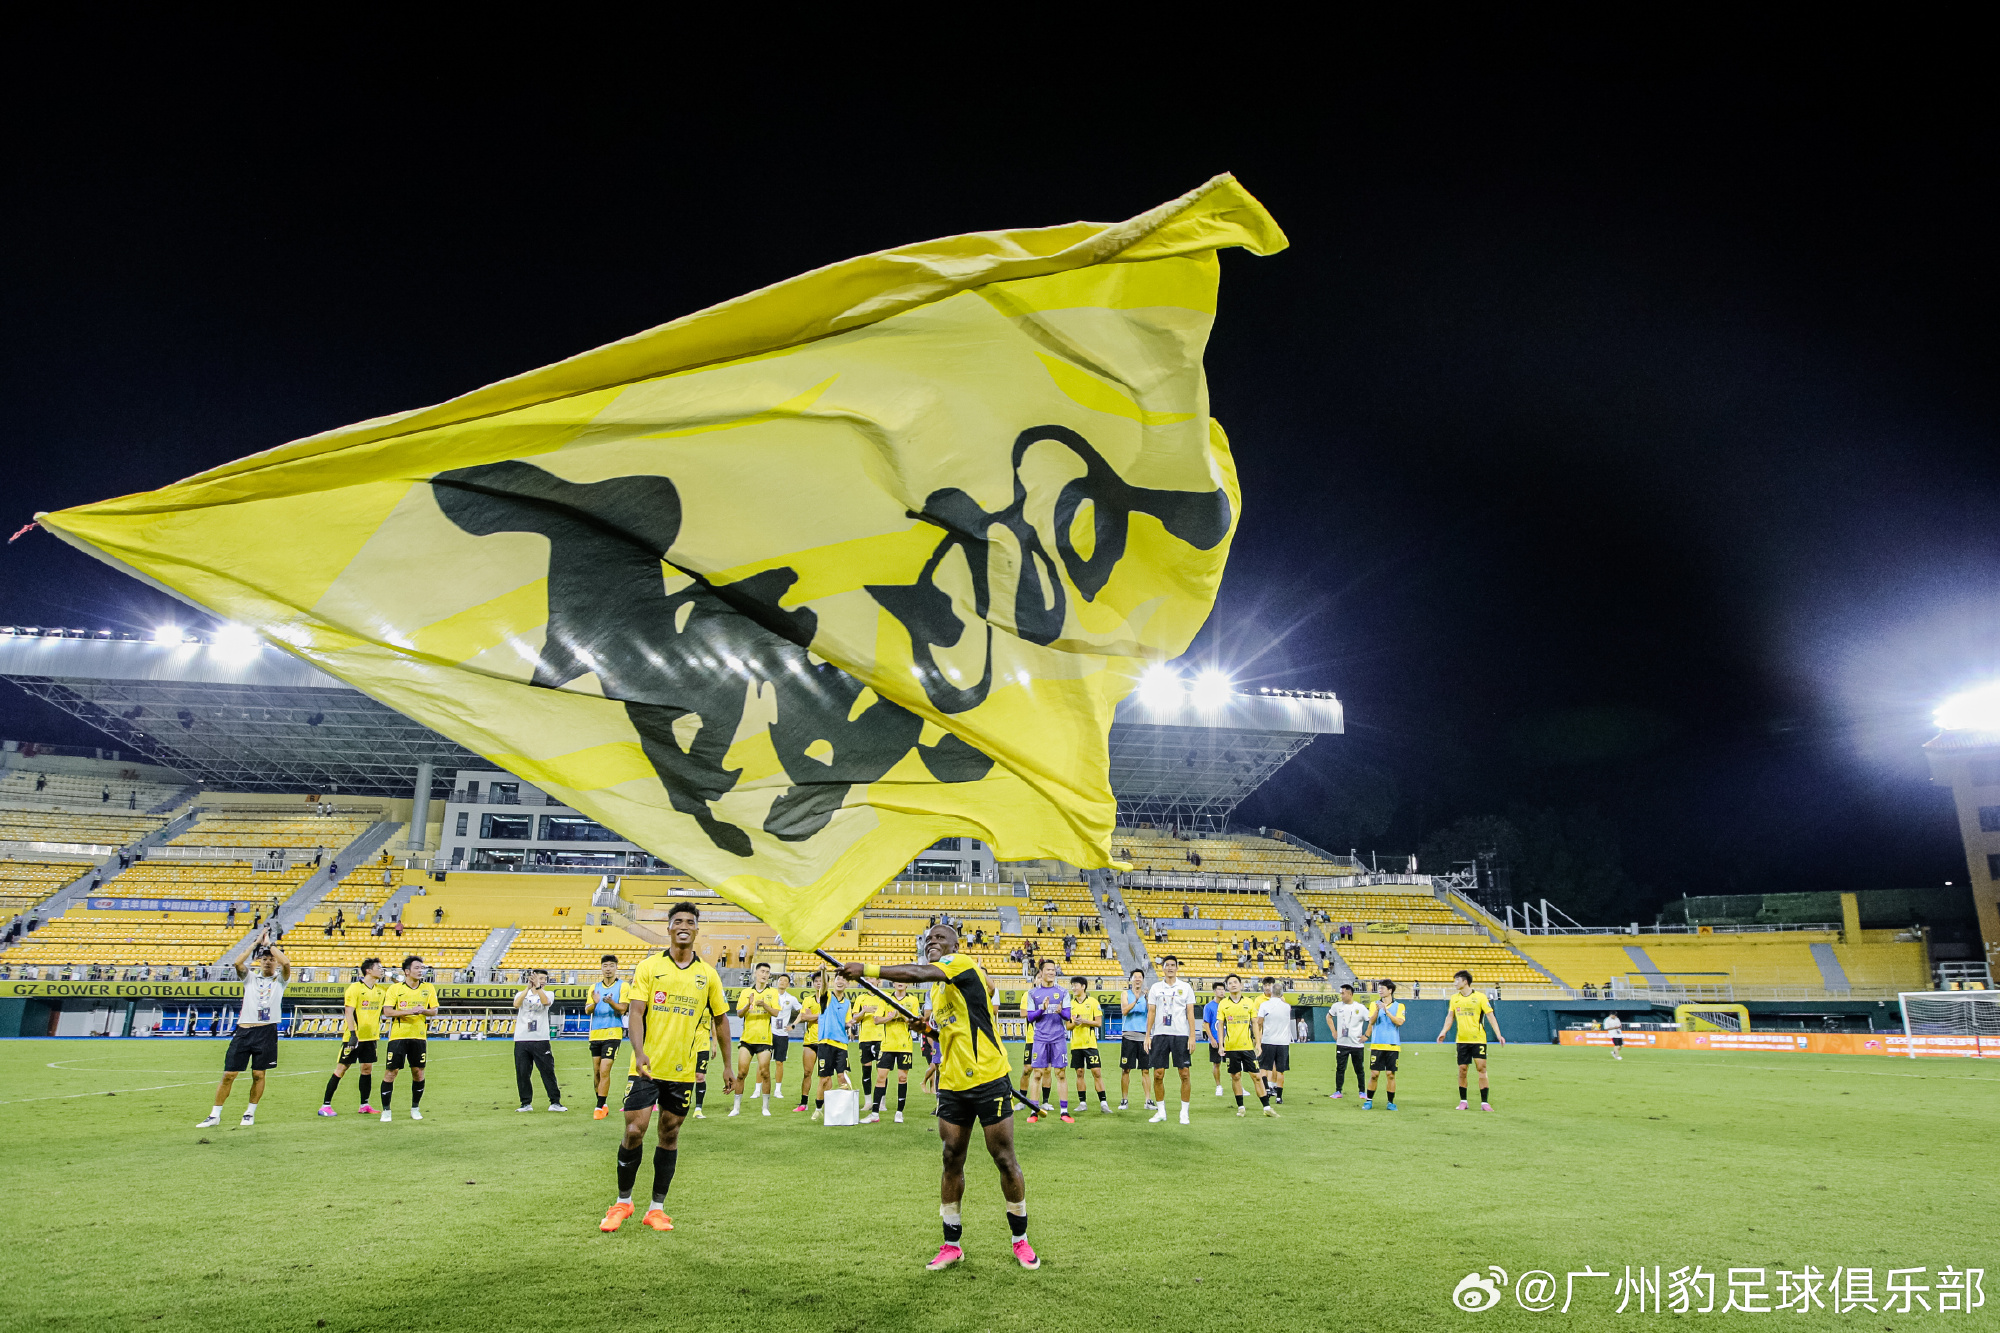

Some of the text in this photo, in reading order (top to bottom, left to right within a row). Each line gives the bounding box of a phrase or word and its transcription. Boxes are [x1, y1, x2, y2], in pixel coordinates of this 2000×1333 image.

[13, 984, 110, 996] GZ-POWER
[116, 984, 205, 996] FOOTBALL
[467, 988, 519, 998] FOOTB
[606, 1046, 613, 1056] 5
[1479, 1045, 1485, 1055] 2
[420, 1052, 426, 1063] 3
[902, 1054, 912, 1065] 24
[1088, 1055, 1099, 1064] 32
[682, 1089, 692, 1108] 3
[993, 1096, 1004, 1117] 7
